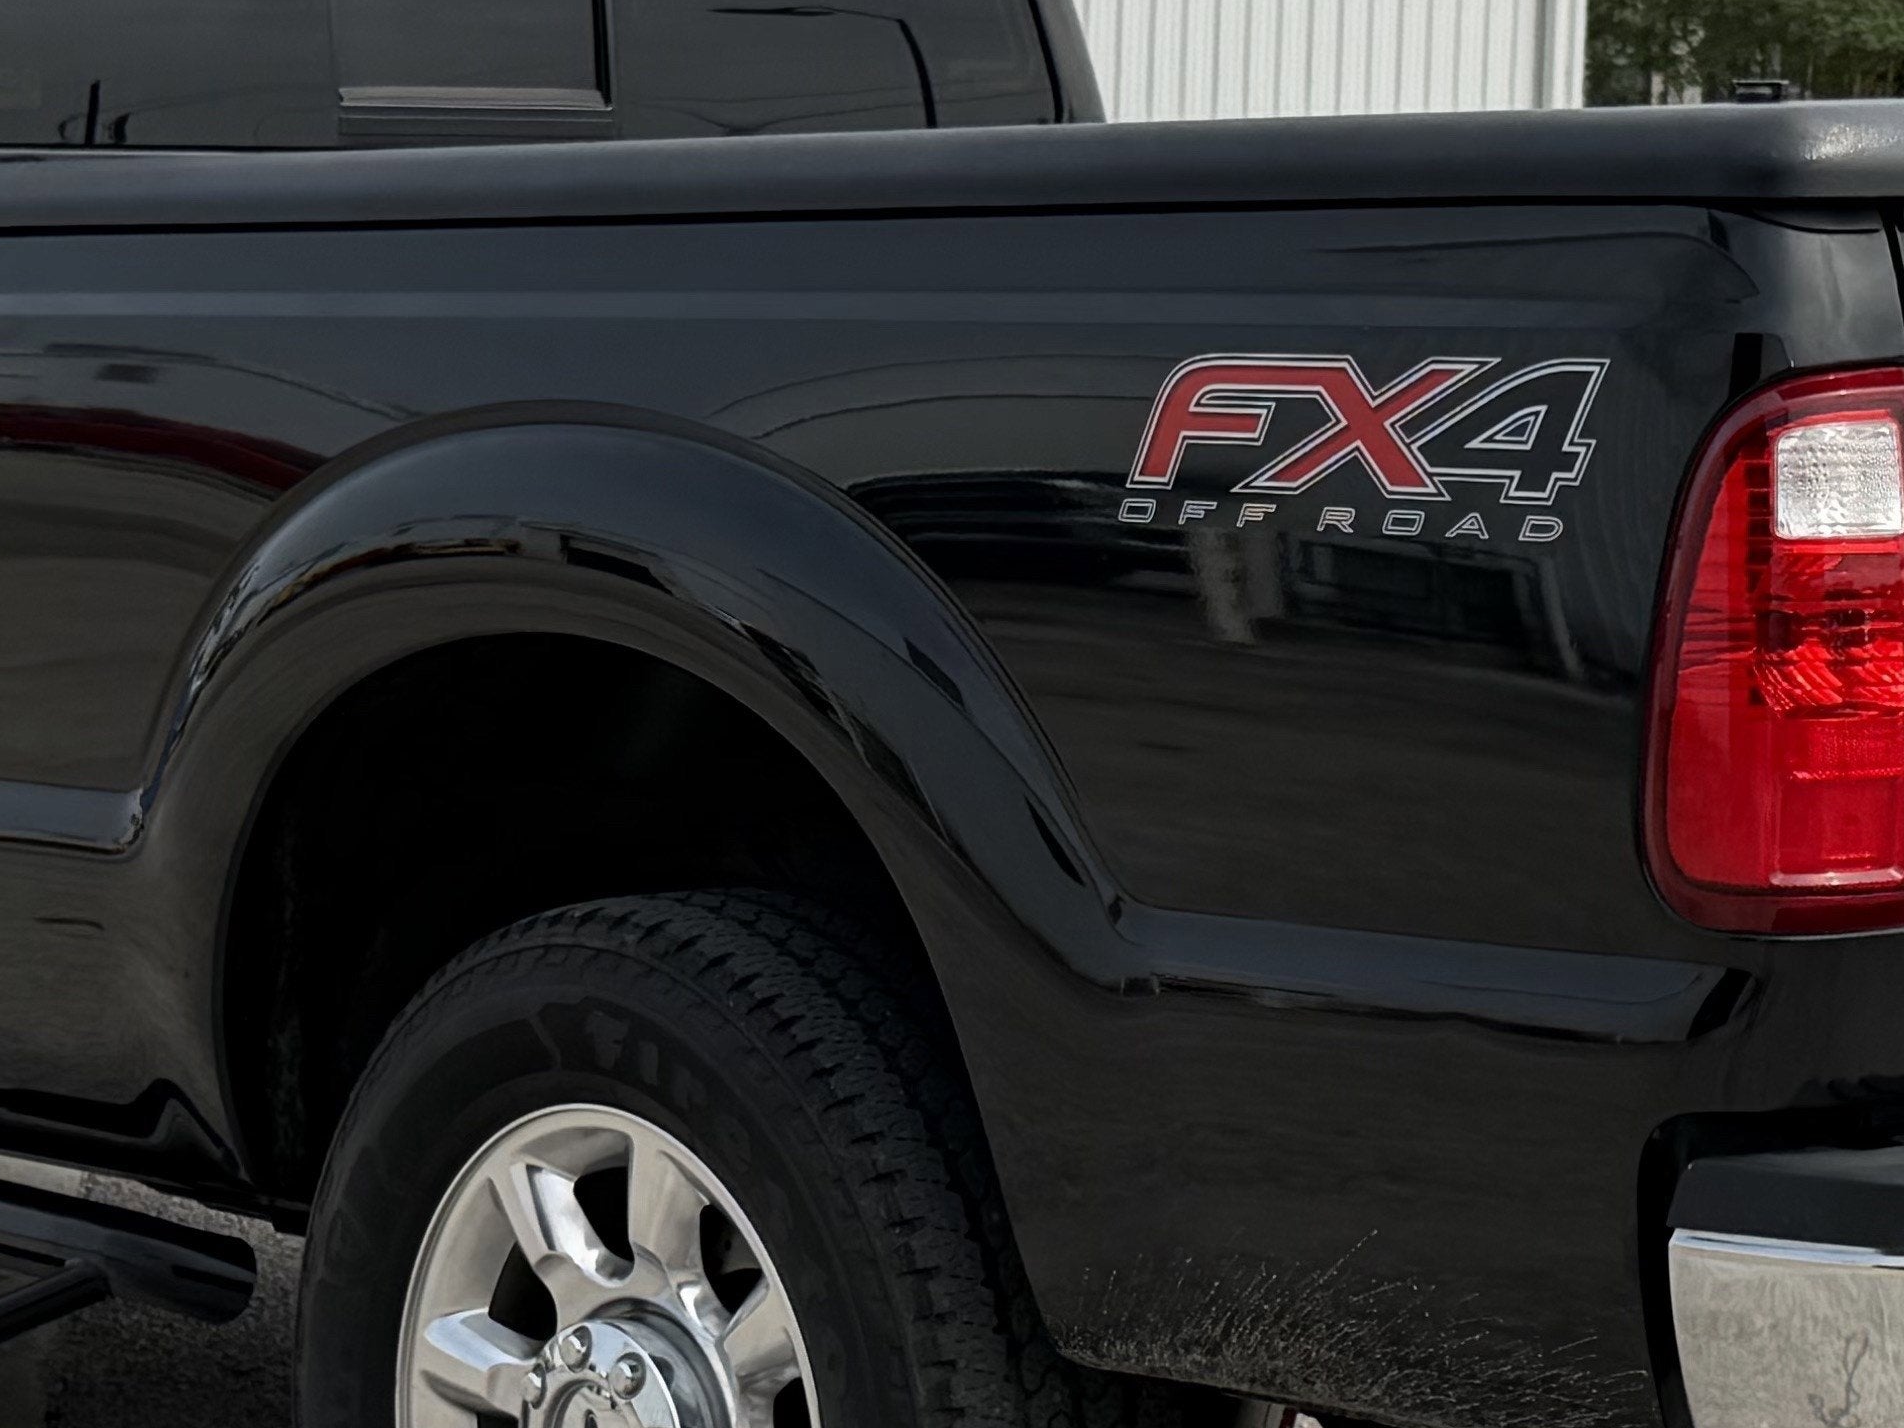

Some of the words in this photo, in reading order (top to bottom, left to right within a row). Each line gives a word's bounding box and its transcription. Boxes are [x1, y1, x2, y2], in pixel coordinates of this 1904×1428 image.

[1126, 352, 1610, 505] FX4
[1117, 498, 1277, 528] OFF
[1315, 507, 1565, 542] ROAD
